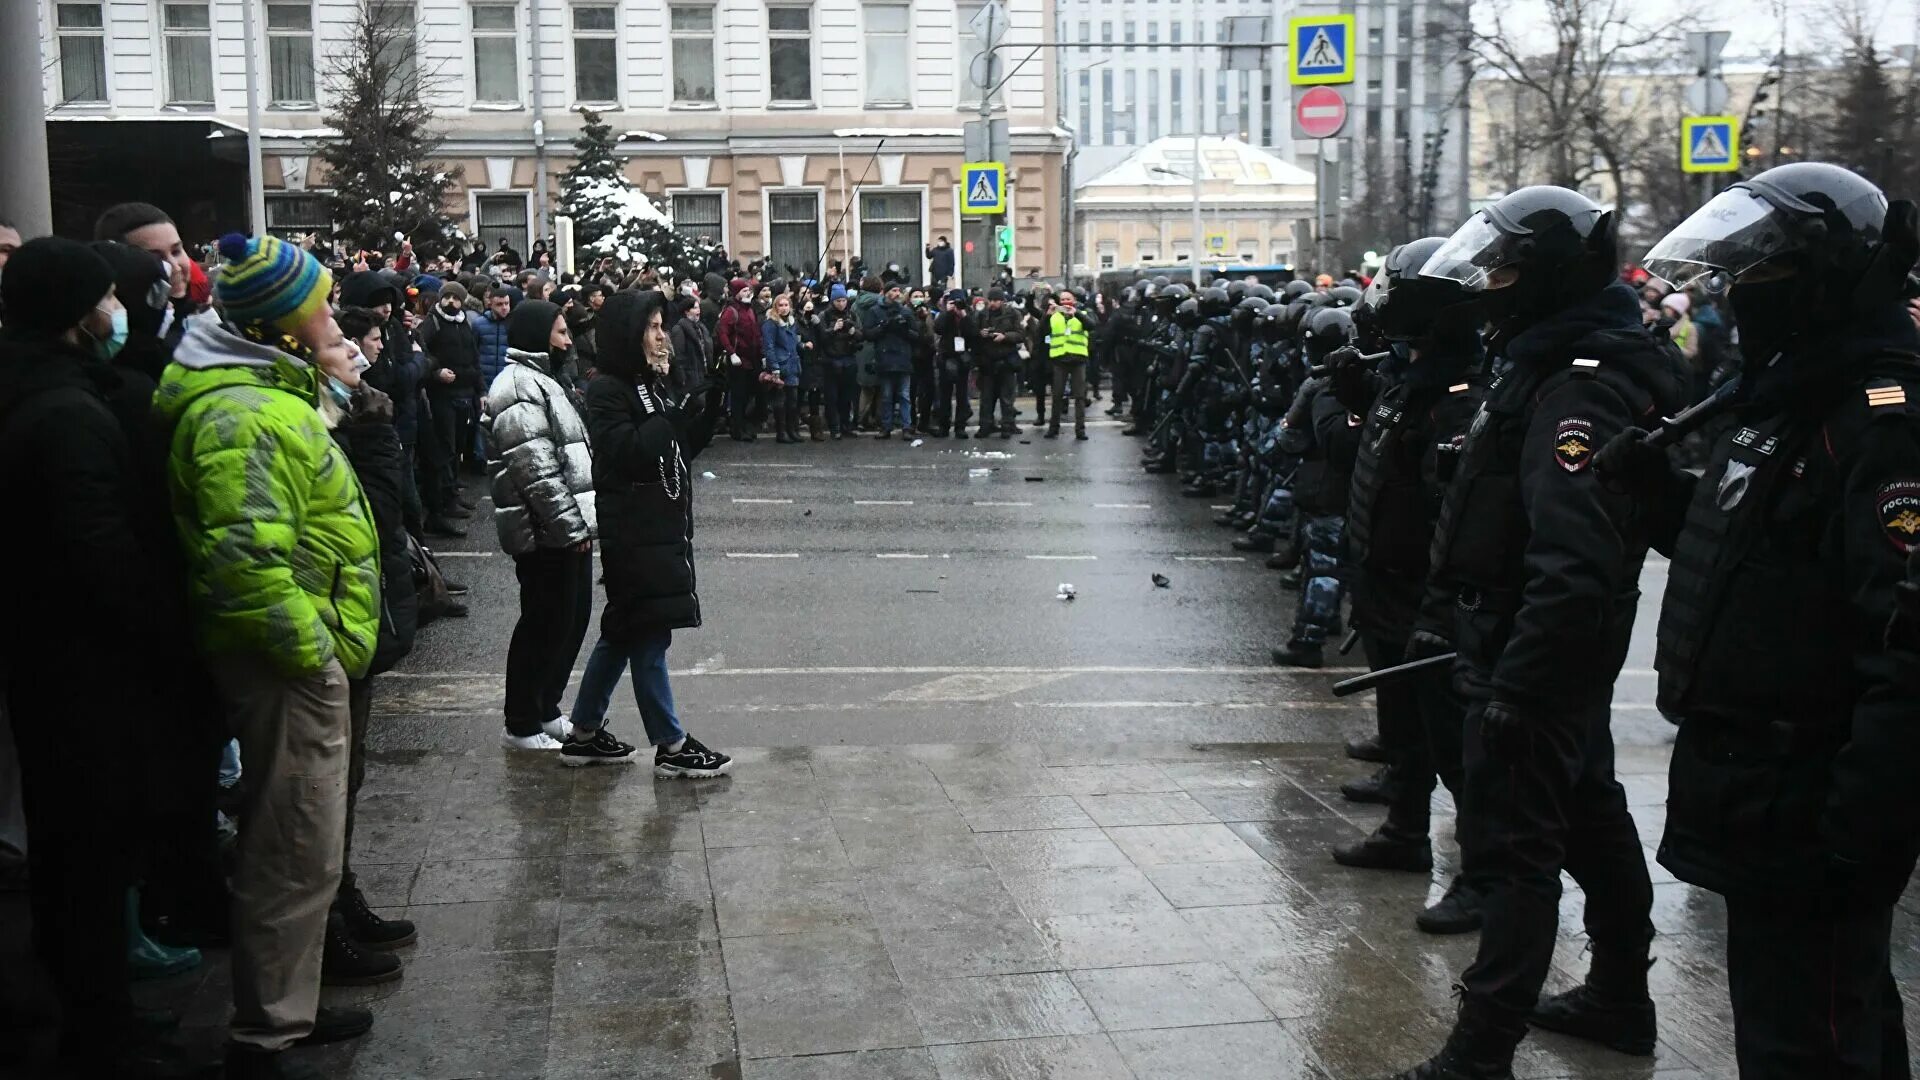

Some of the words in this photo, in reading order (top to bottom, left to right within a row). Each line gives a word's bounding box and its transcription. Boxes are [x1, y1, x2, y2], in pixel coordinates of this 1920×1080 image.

[637, 384, 655, 413] WINTER
[1558, 430, 1589, 441] РОССИЯ
[1883, 497, 1920, 514] РОССИ
